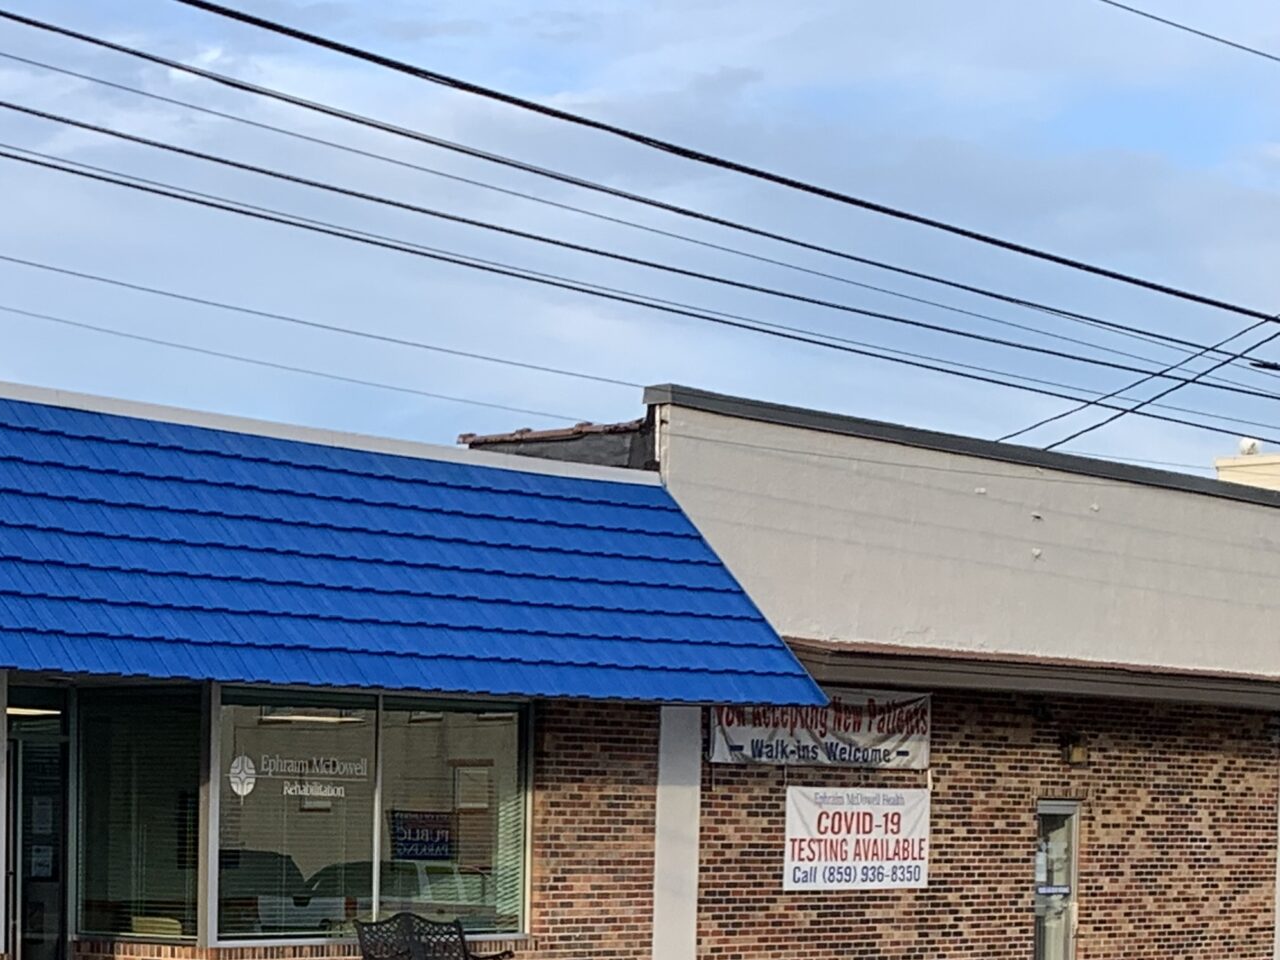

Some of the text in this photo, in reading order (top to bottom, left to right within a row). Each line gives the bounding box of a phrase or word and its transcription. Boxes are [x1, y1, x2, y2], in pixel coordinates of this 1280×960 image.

[752, 705, 828, 737] Accepting
[832, 696, 862, 733] New
[867, 697, 928, 736] Patients
[750, 739, 891, 763] Walk-ins Welcome
[261, 754, 368, 777] Ephraim McDowell
[282, 780, 346, 798] Rehabilitation
[817, 811, 902, 835] COVID-19
[789, 838, 926, 862] TESTING AVAILABLE
[792, 864, 921, 884] Call (859) 936-8350
